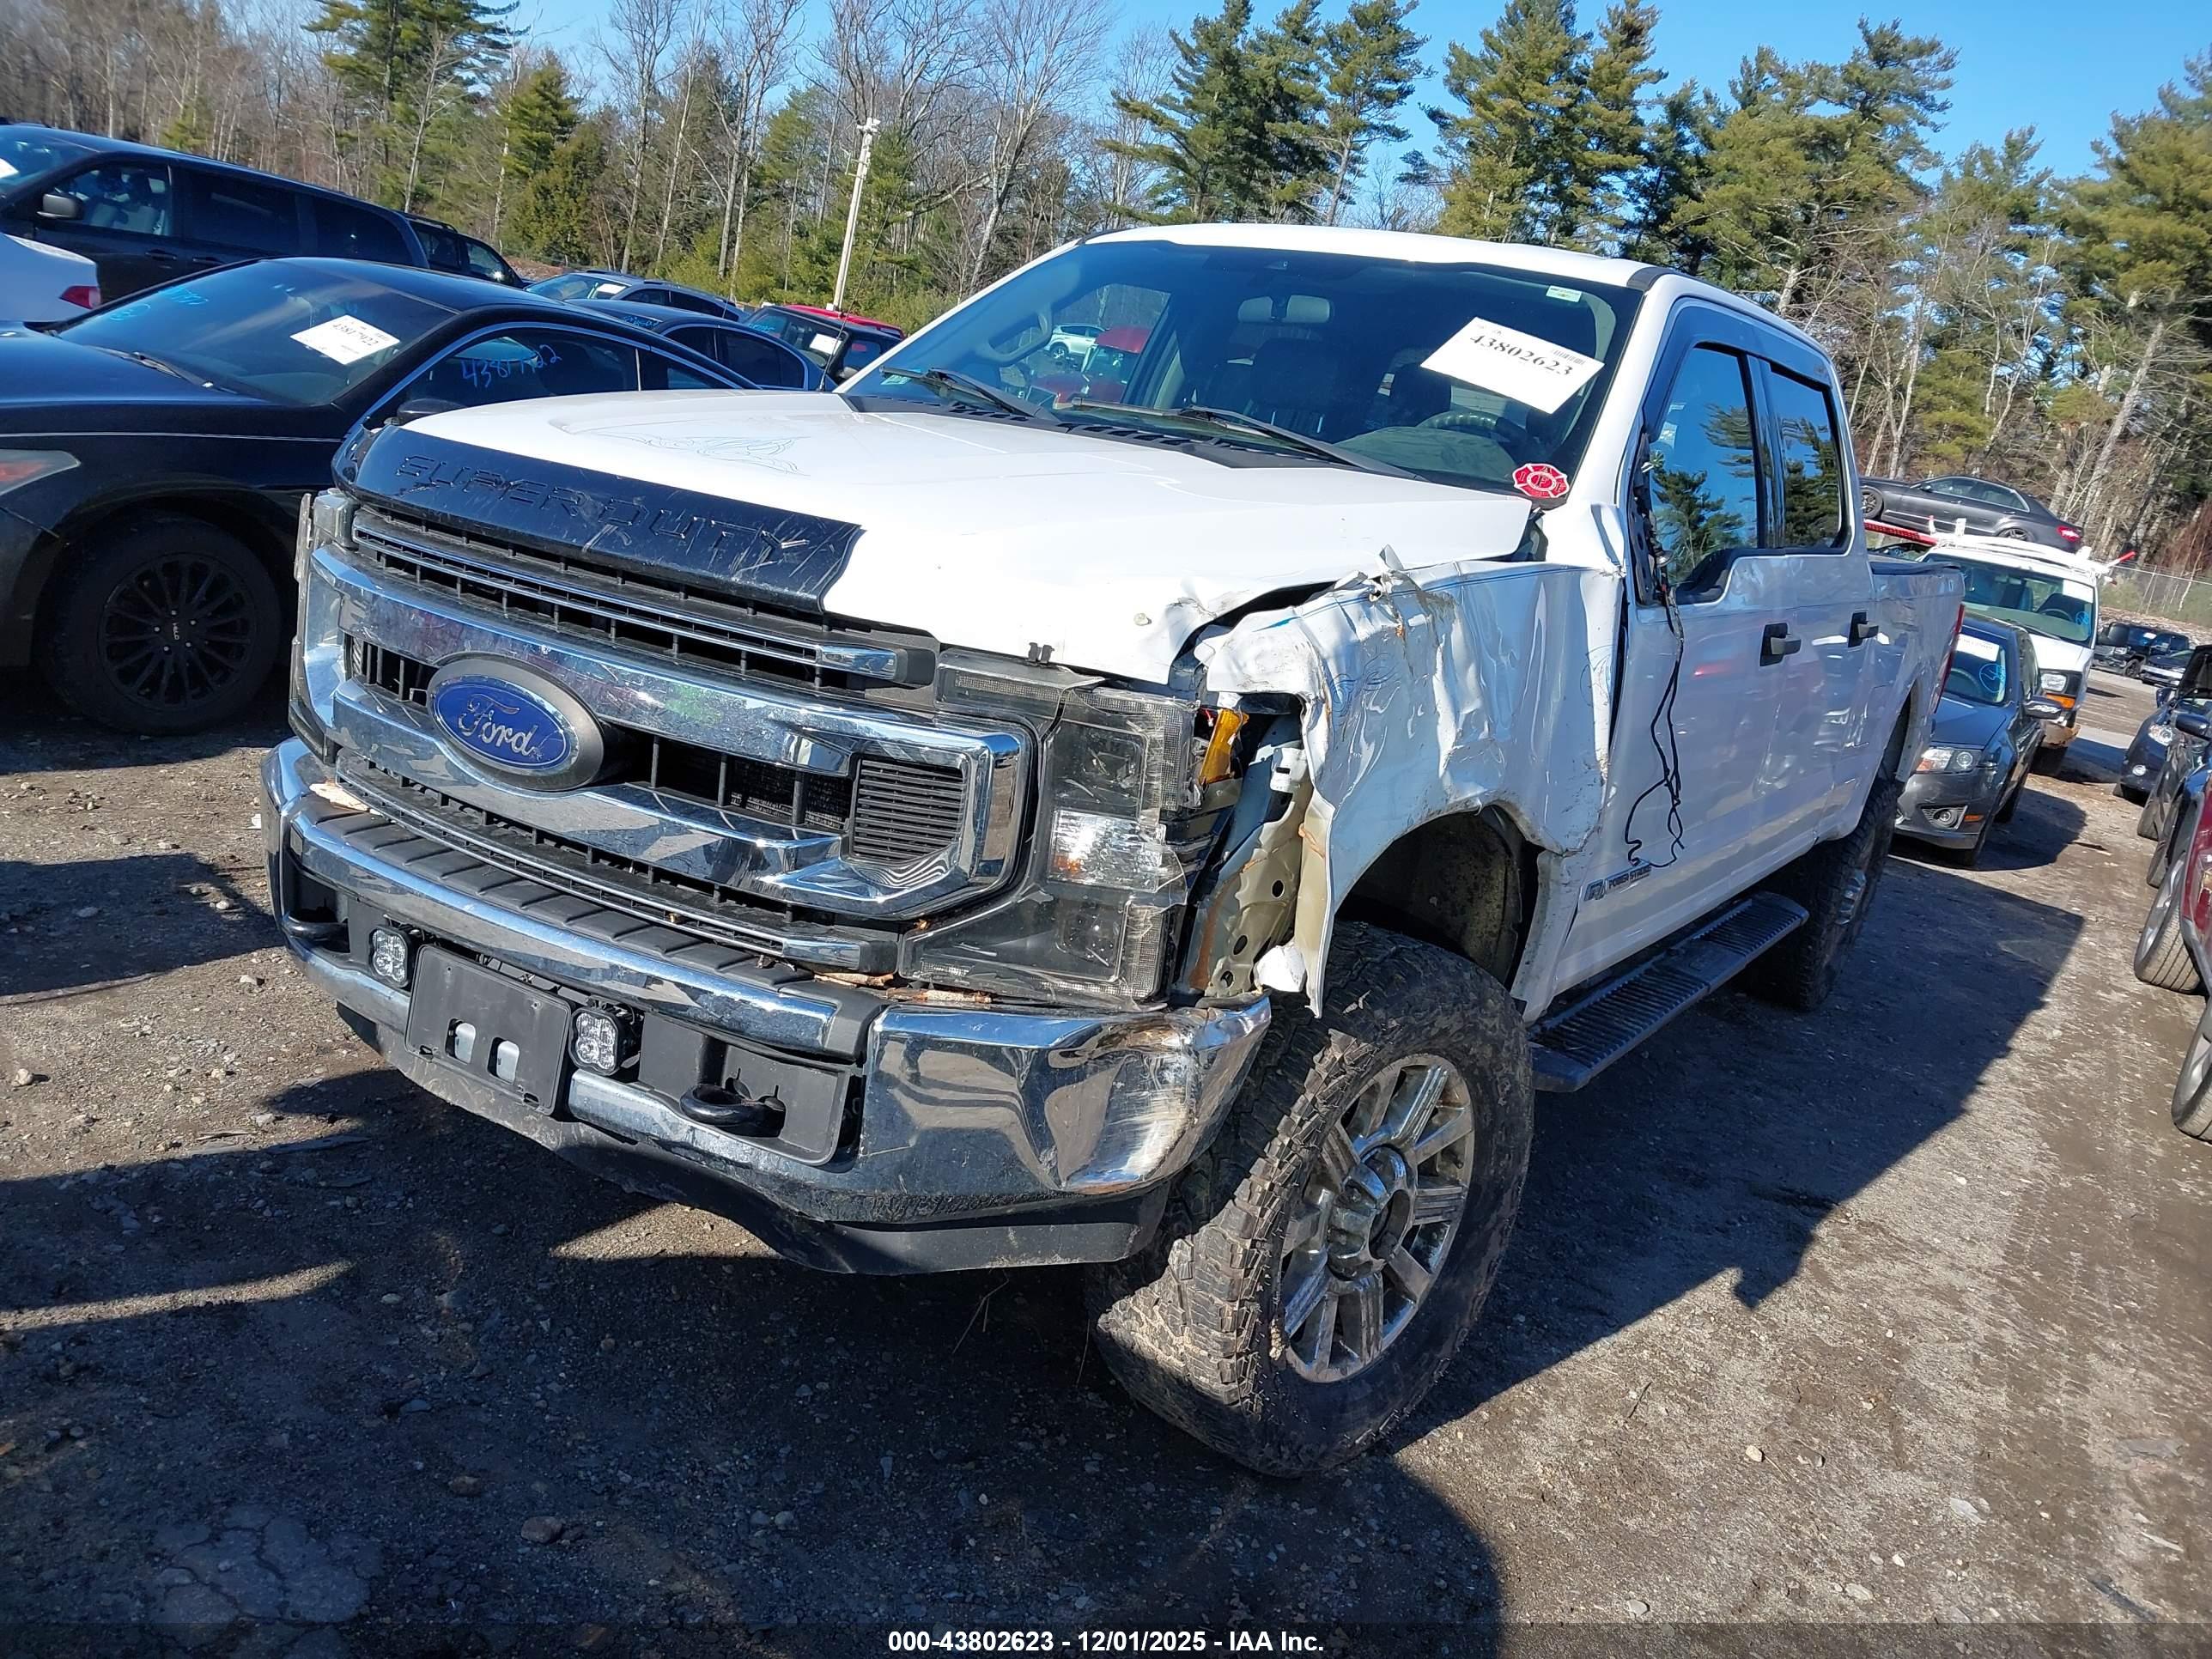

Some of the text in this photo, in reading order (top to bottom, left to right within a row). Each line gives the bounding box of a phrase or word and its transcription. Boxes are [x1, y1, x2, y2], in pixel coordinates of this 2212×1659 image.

[1469, 334, 1574, 375] 43802623
[396, 455, 810, 567] SUPER DUTY
[458, 693, 538, 757] Ford
[1608, 873, 1630, 889] POWER
